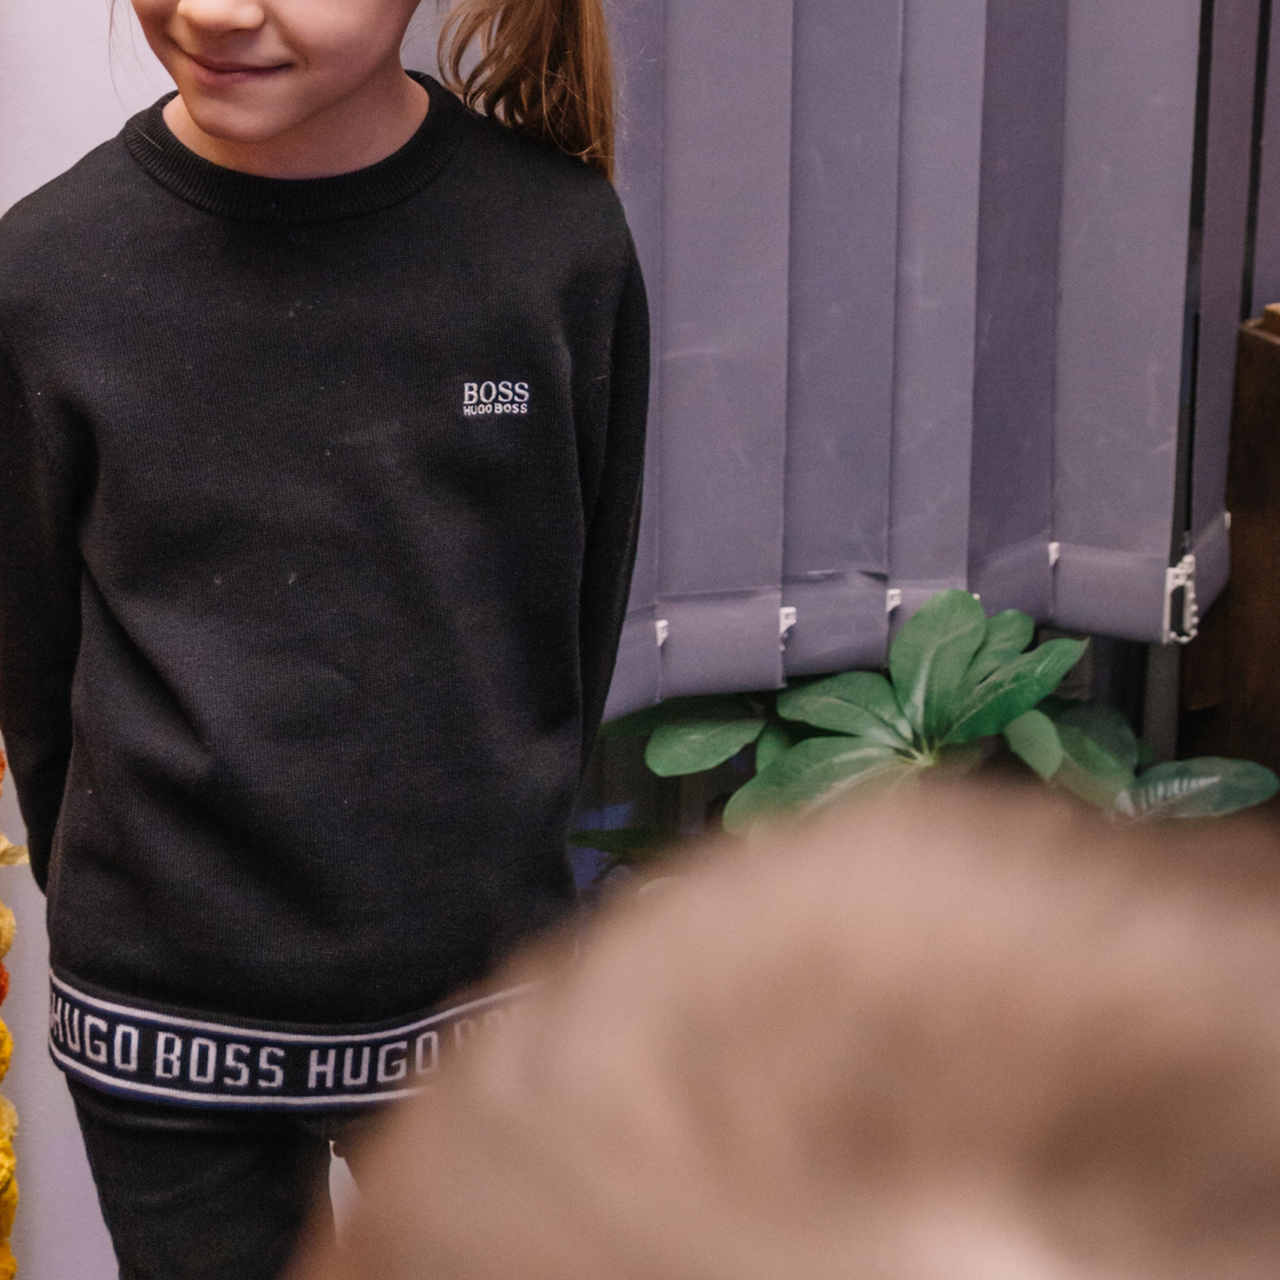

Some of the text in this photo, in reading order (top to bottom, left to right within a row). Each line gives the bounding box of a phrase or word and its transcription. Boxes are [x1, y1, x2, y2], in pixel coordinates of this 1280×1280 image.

[463, 381, 530, 404] BOSS
[463, 403, 528, 415] HUGO BOSS
[50, 993, 439, 1089] HUGO BOSS HUGO
